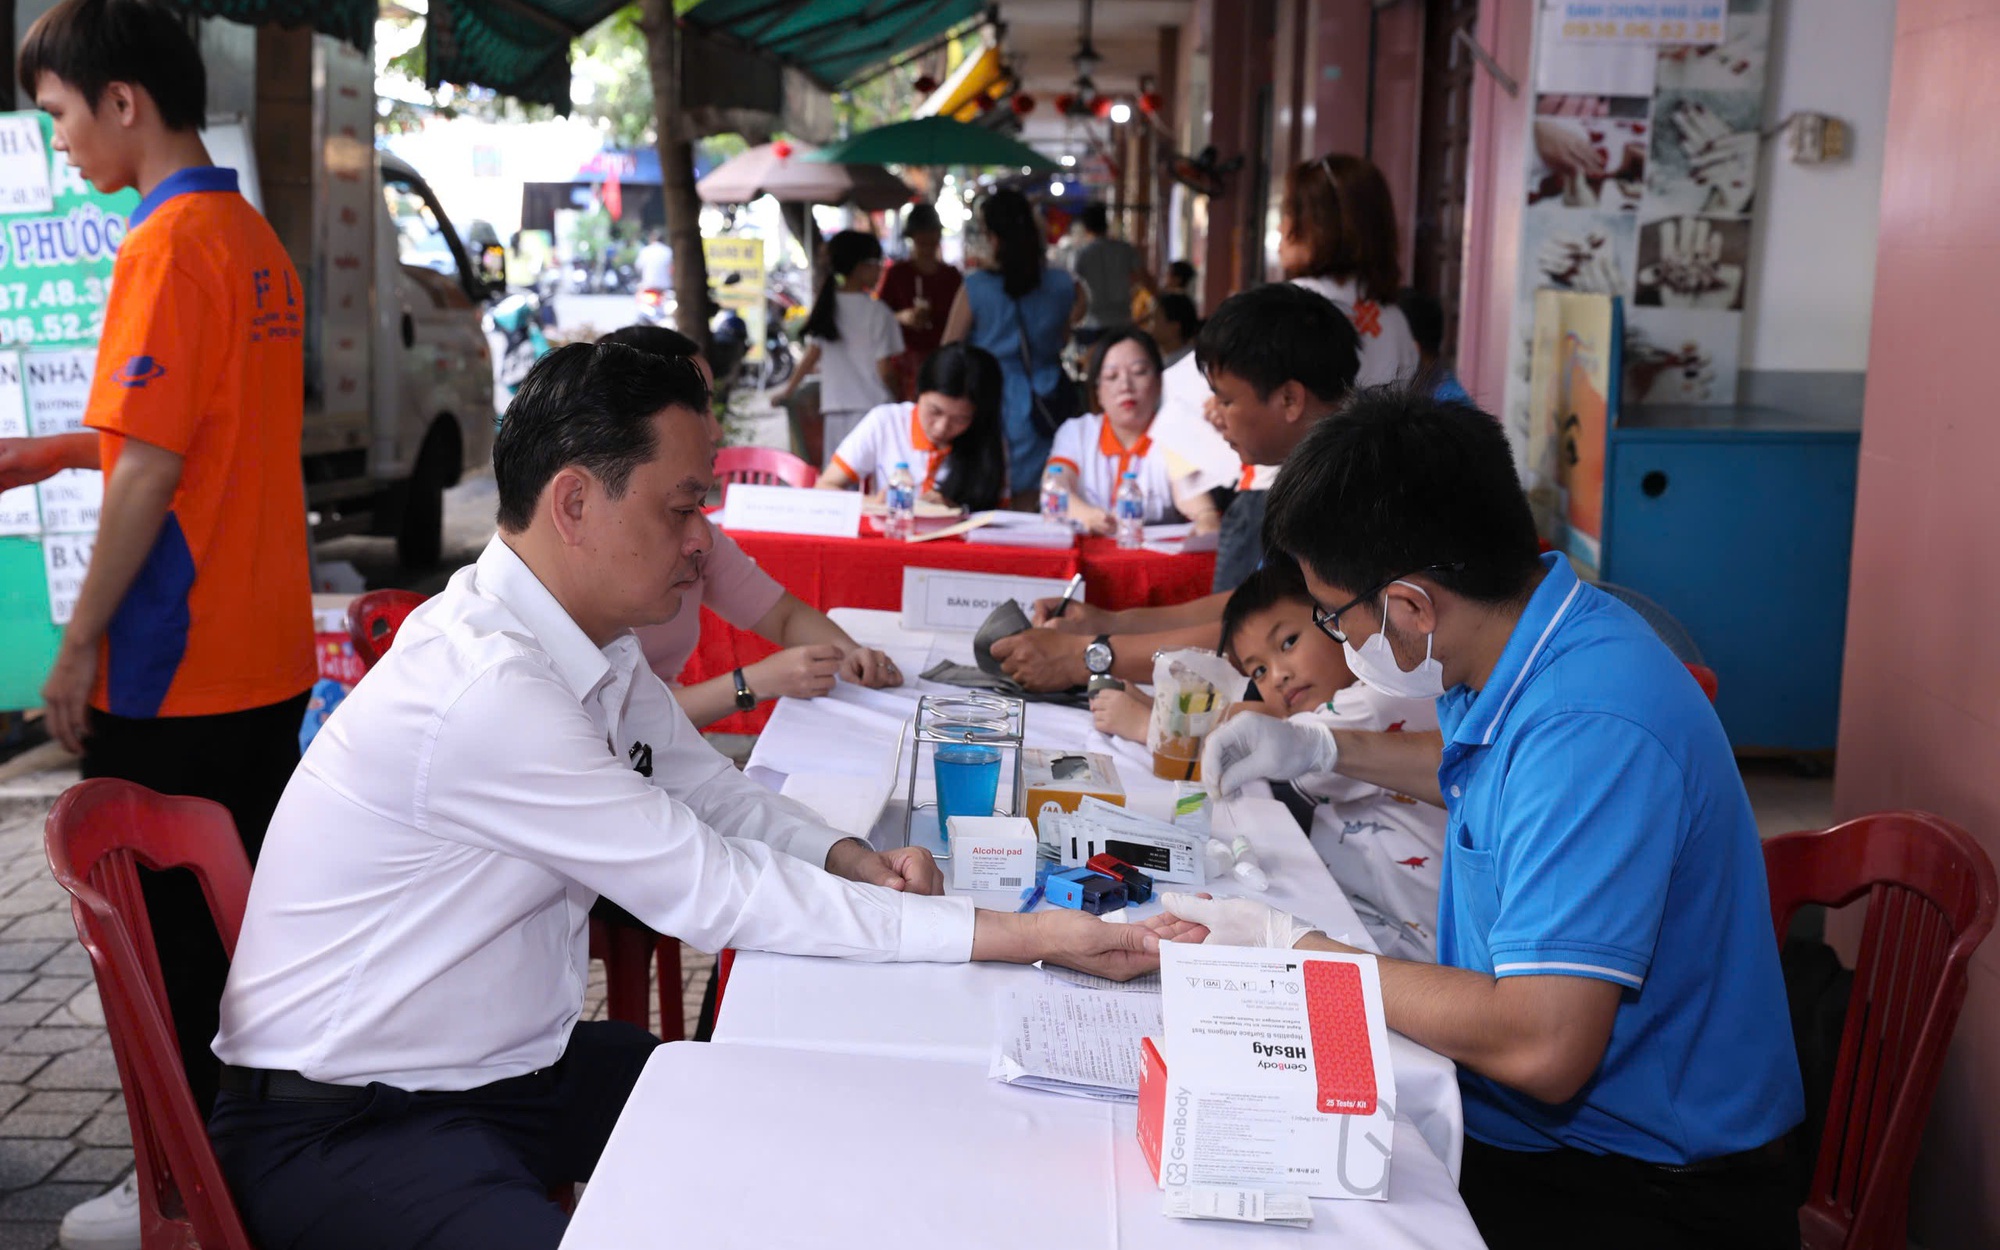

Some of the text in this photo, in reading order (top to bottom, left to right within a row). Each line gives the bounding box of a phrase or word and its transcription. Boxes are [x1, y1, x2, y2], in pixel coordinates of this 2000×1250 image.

[972, 847, 1023, 857] Alcohol pad
[1191, 1027, 1206, 1035] Test
[1208, 1028, 1238, 1037] Antigens
[1239, 1030, 1265, 1039] Surface
[1273, 1032, 1304, 1041] Hepatitis
[1252, 1041, 1307, 1059] HBsAg
[1257, 1060, 1308, 1073] GenBody
[1326, 1098, 1335, 1107] 25
[1357, 1100, 1367, 1109] Kit
[1170, 1086, 1192, 1160] GenBody
